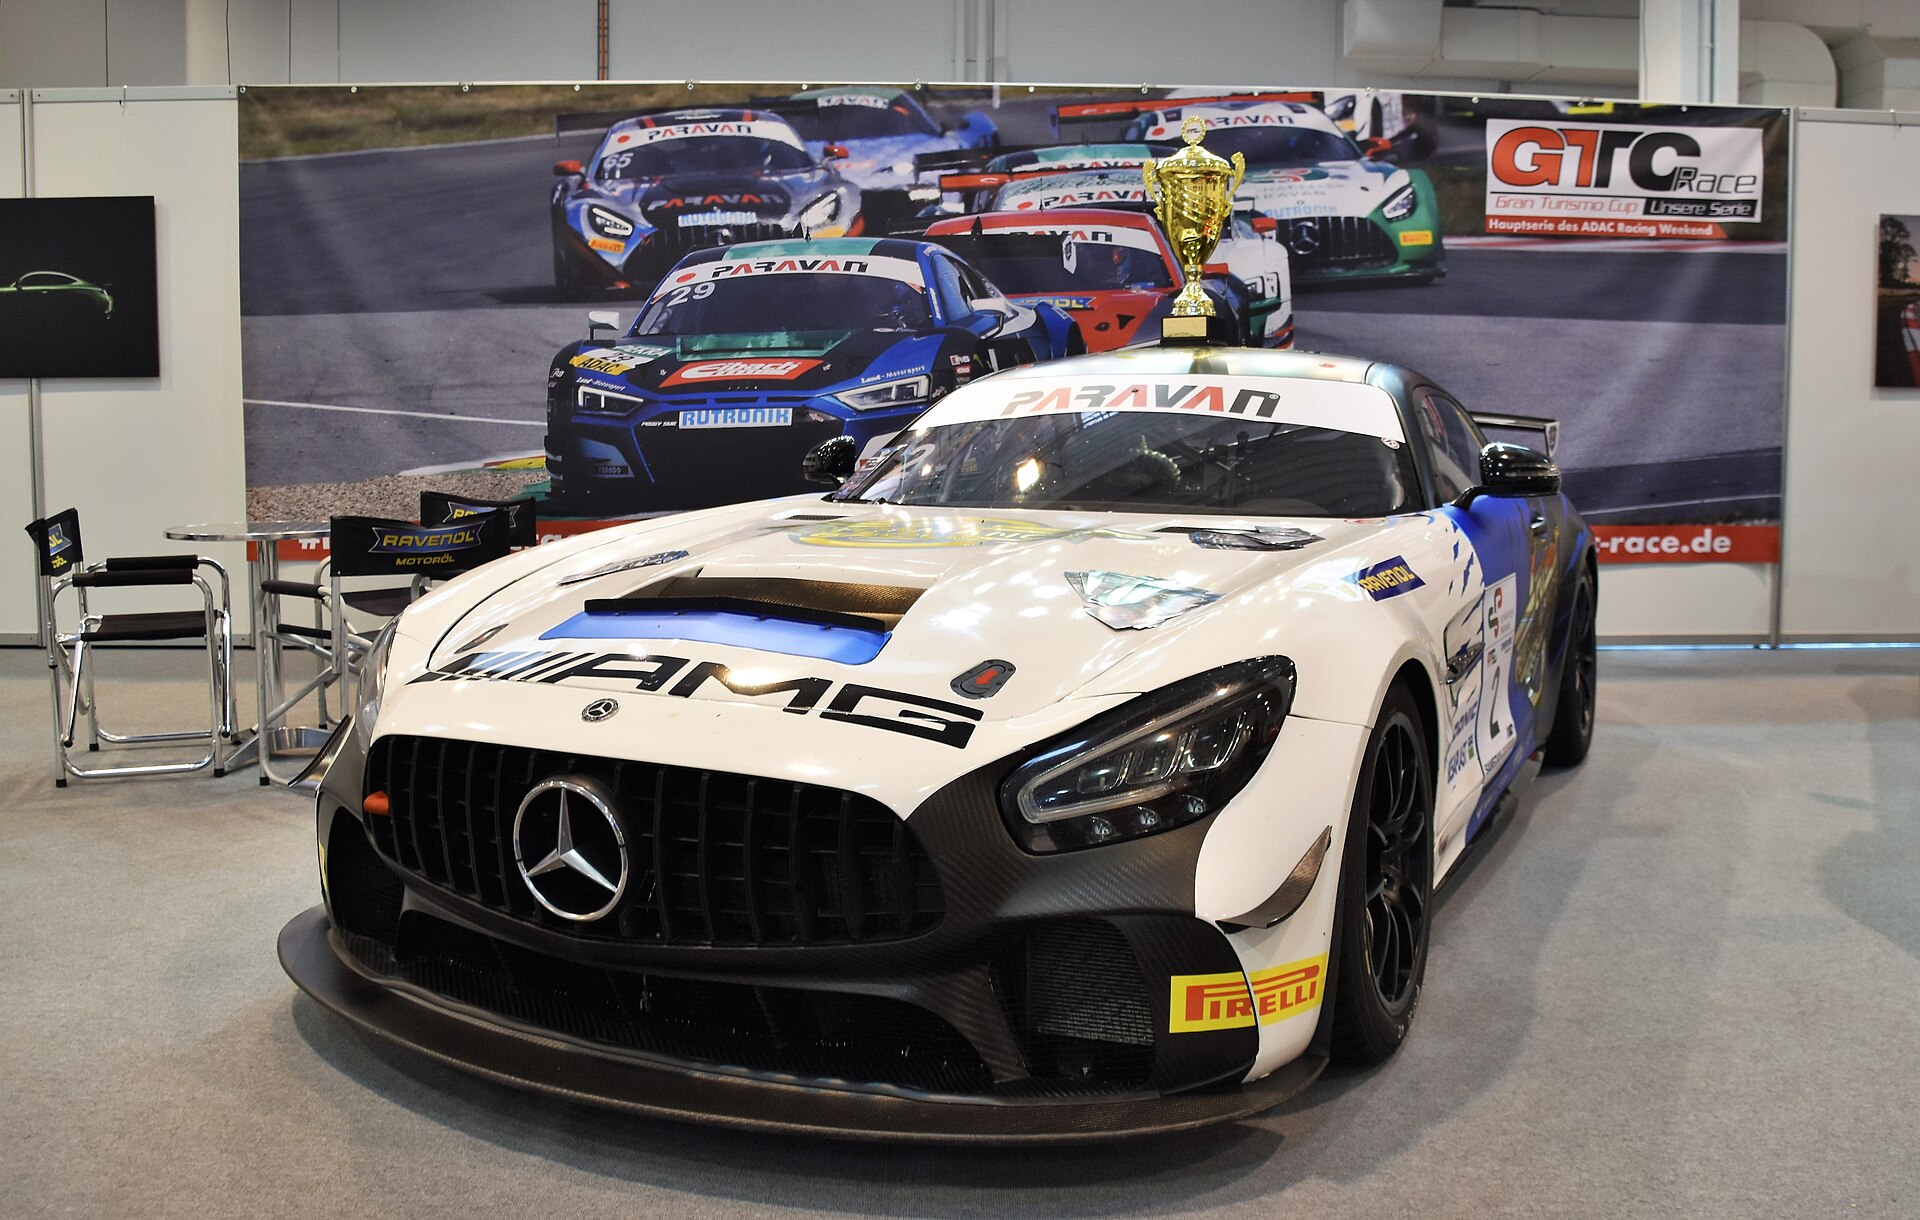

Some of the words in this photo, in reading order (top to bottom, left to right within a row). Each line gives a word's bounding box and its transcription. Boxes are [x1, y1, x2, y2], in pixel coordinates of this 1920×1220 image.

[1203, 113, 1294, 127] ARAVAN
[648, 123, 753, 140] PARAVAN
[602, 152, 634, 170] 65
[1491, 126, 1702, 191] GTC
[1673, 165, 1757, 194] Race
[1494, 195, 1535, 209] Gran
[1541, 196, 1603, 211] Turismo
[1608, 199, 1639, 214] Cup
[1650, 200, 1706, 216] Unsere
[1709, 202, 1752, 216] Serie
[1488, 218, 1556, 234] Hauptserie
[1557, 221, 1579, 233] des
[1580, 222, 1615, 234] ADAC
[1616, 223, 1657, 237] Racing
[1658, 224, 1713, 237] Weekend
[712, 258, 869, 279] PARAVAN
[666, 281, 716, 307] 29
[578, 358, 620, 373] ADAC
[1000, 384, 1281, 419] PARAVAN
[682, 408, 789, 427] RUTRONIK
[382, 530, 475, 547] RAVENOL
[395, 553, 455, 567] MOTORÖL
[1359, 565, 1416, 593] RAVENOL
[1488, 666, 1500, 740] 2
[1184, 964, 1320, 1022] PIRELLI
